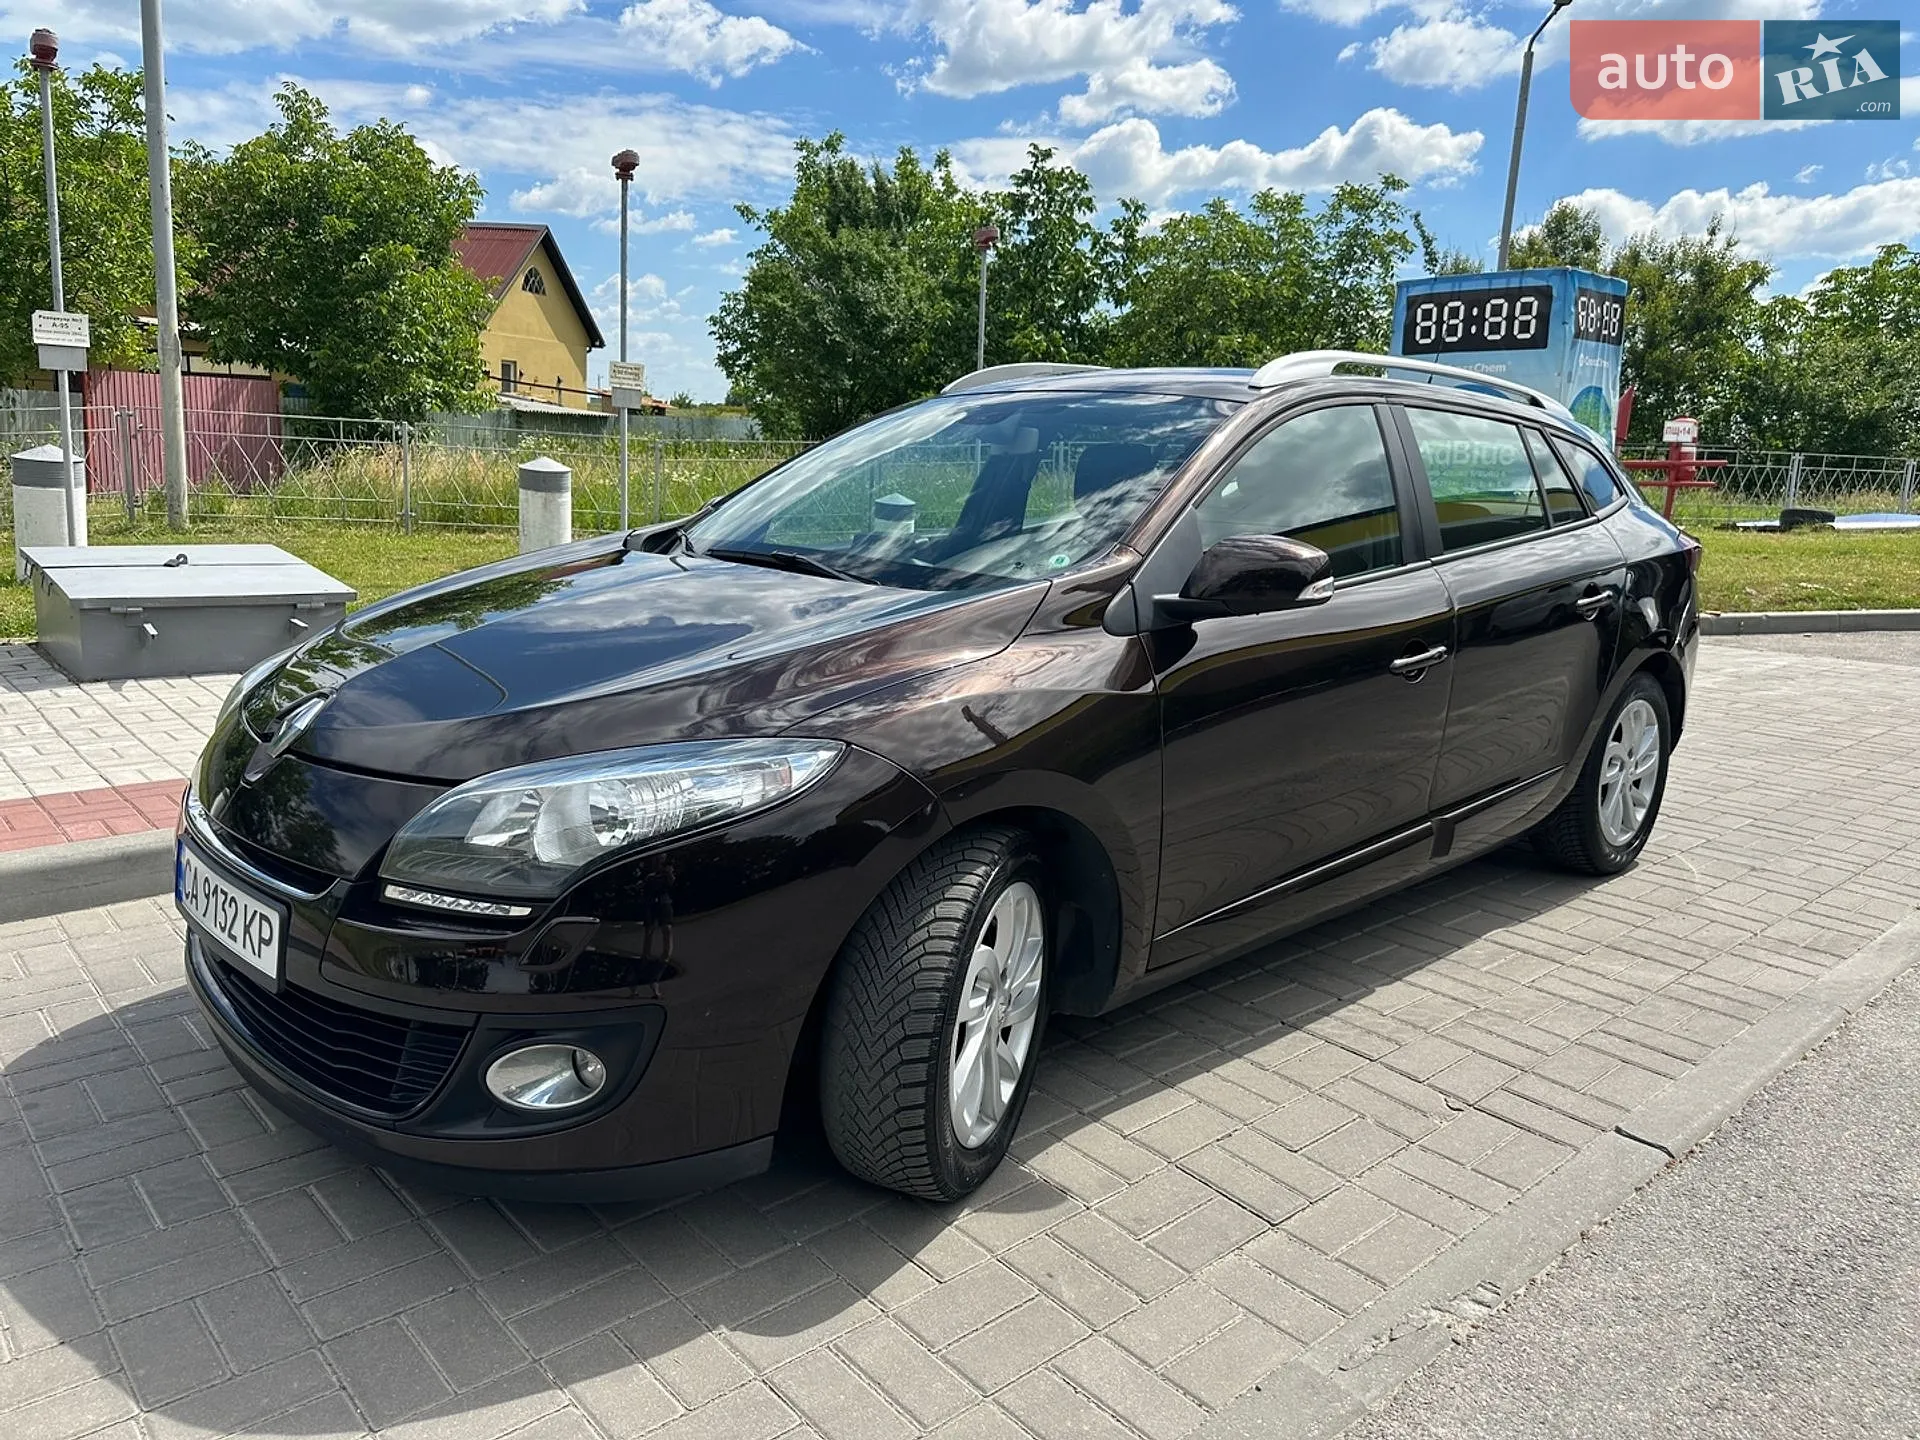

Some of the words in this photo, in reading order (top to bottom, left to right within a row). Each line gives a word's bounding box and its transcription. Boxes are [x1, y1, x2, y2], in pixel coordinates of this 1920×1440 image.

[1415, 296, 1538, 344] 88:88
[184, 857, 199, 911] CA
[203, 876, 239, 943] 9132
[242, 904, 274, 959] KP
